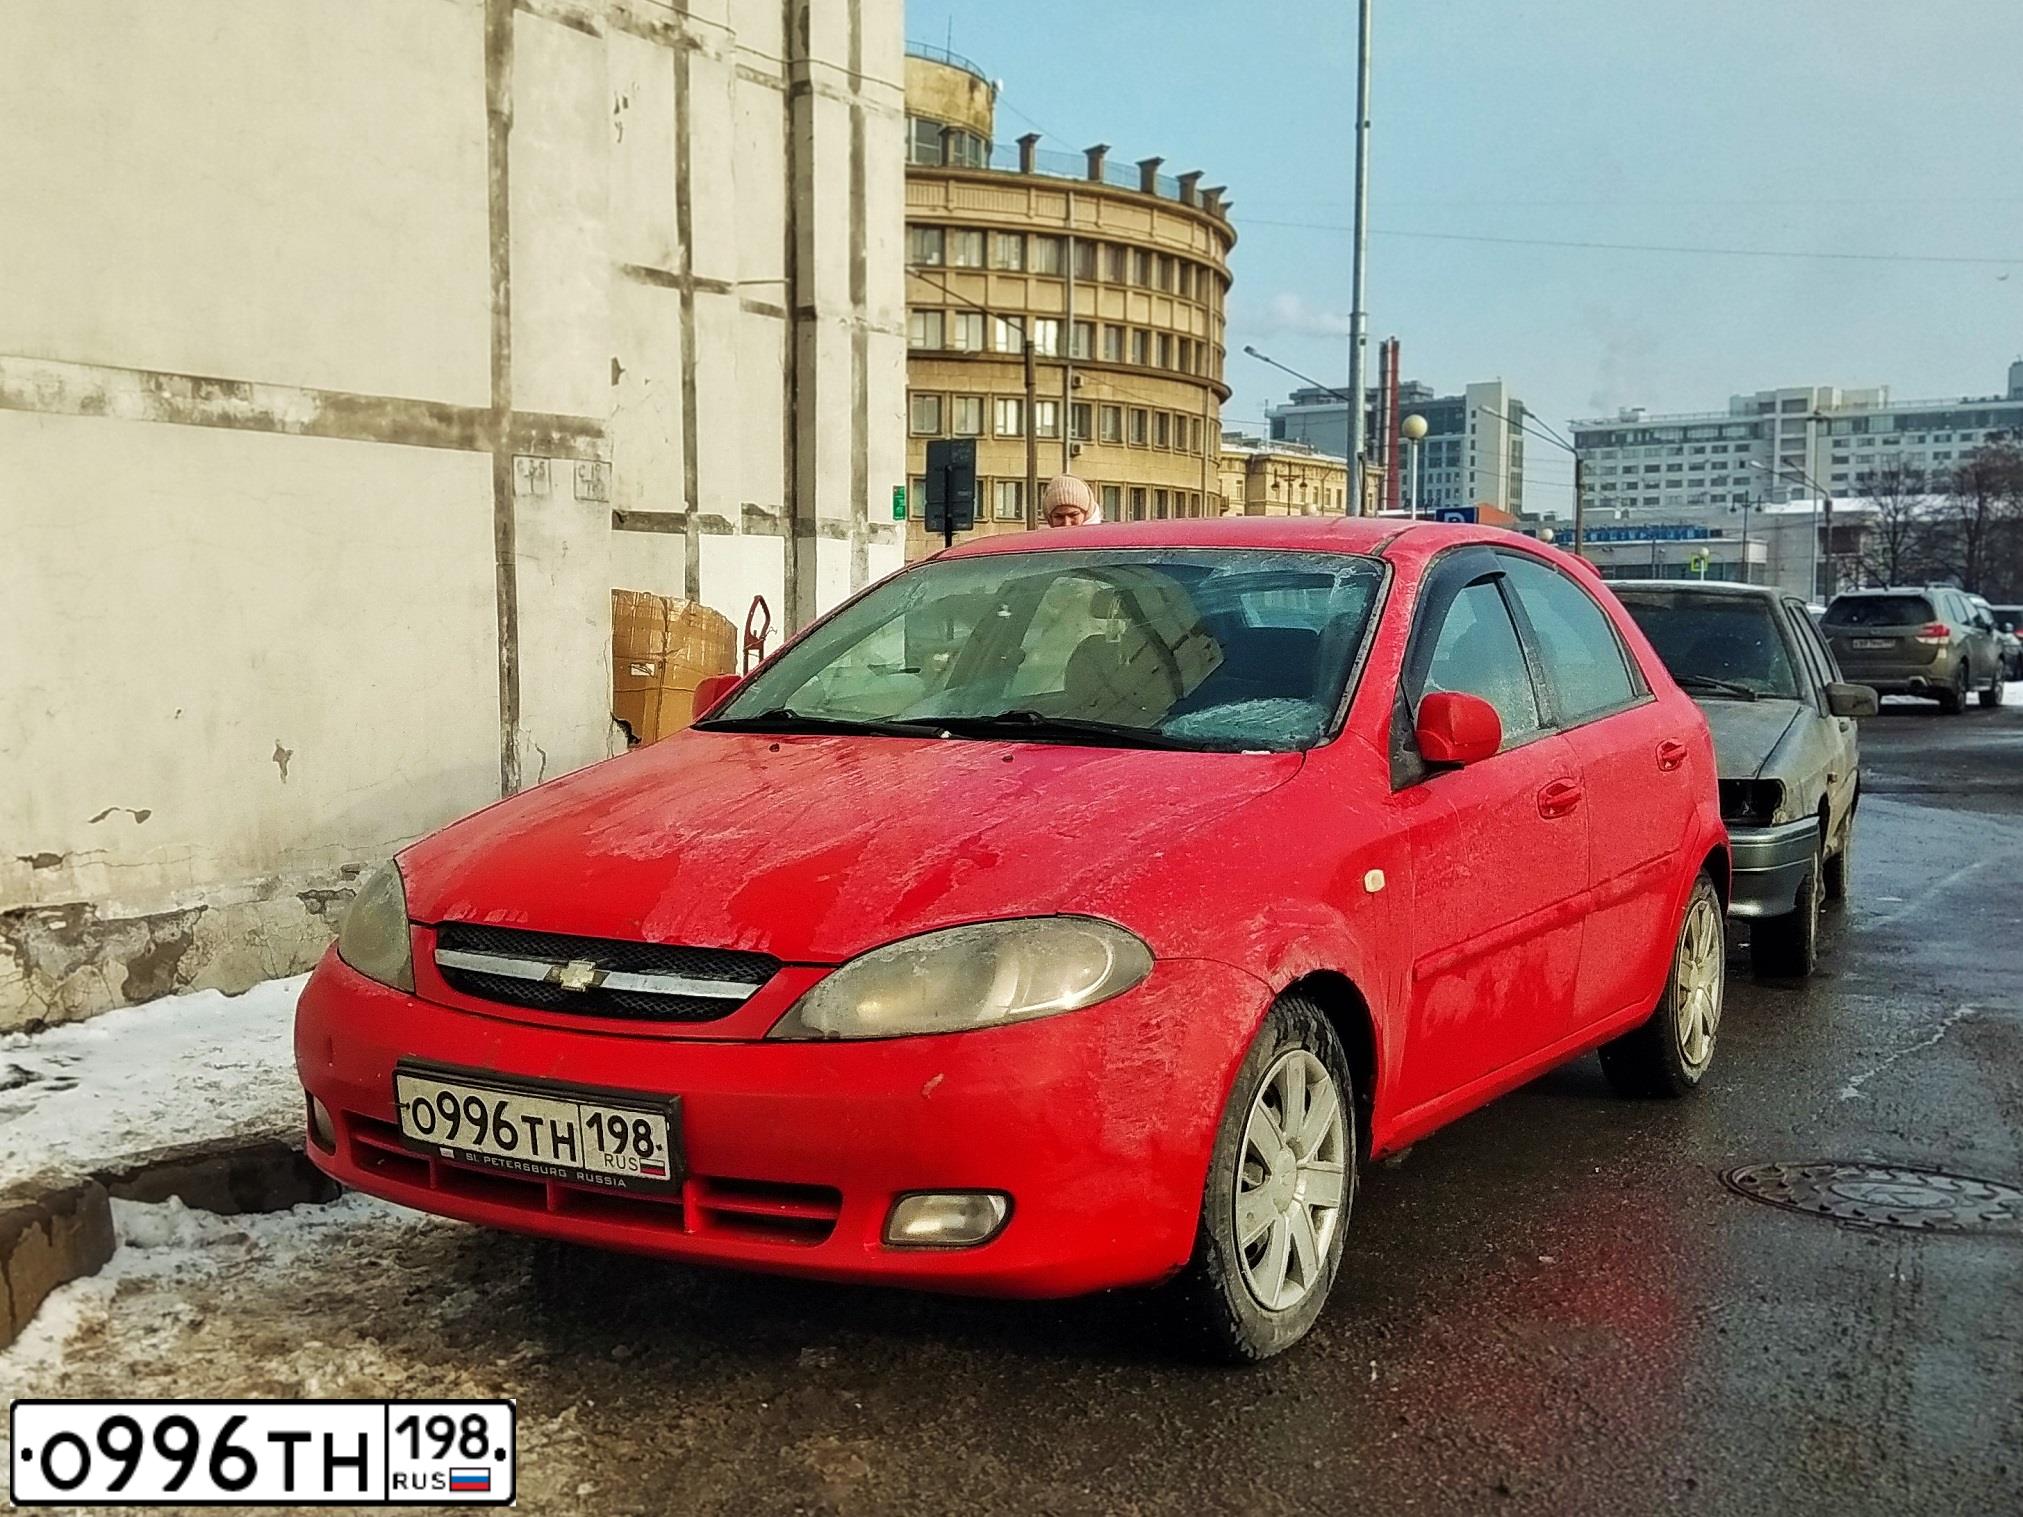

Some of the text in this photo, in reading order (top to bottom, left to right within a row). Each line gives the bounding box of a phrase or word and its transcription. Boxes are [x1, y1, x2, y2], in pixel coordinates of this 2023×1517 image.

[585, 1112, 654, 1158] 198
[483, 1156, 567, 1178] PETERSBURG
[576, 1171, 627, 1188] RUSSIA
[604, 1153, 638, 1171] RUS
